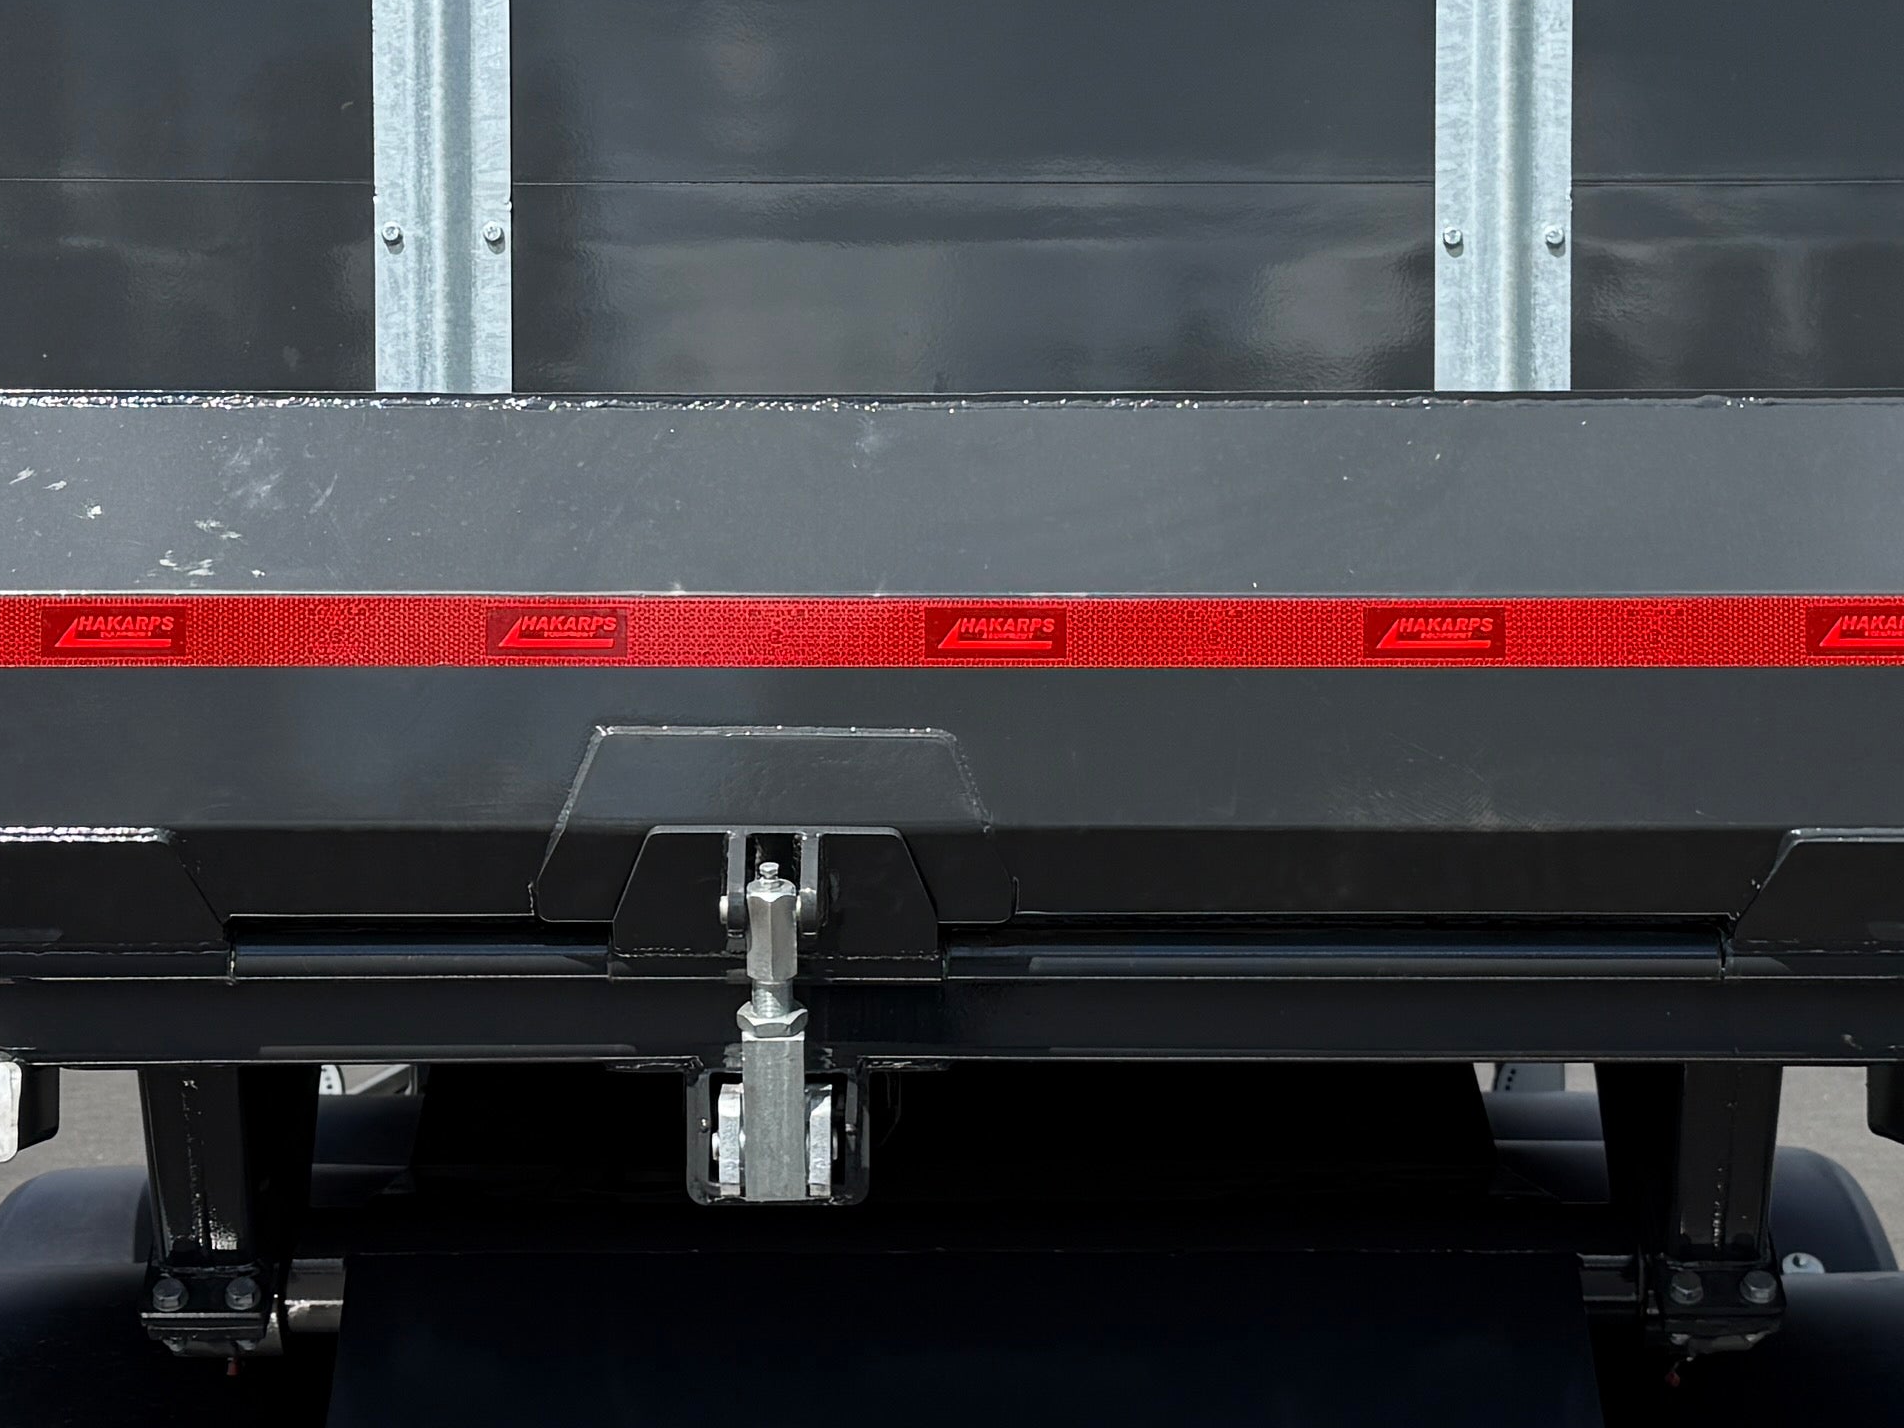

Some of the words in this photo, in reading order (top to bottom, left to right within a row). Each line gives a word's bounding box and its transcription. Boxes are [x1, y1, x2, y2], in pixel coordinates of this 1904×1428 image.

[78, 615, 175, 631] HAKARPS
[521, 615, 617, 631] HAKARPS
[960, 617, 1056, 633] HAKARPS
[1399, 617, 1494, 632] HAKARPS
